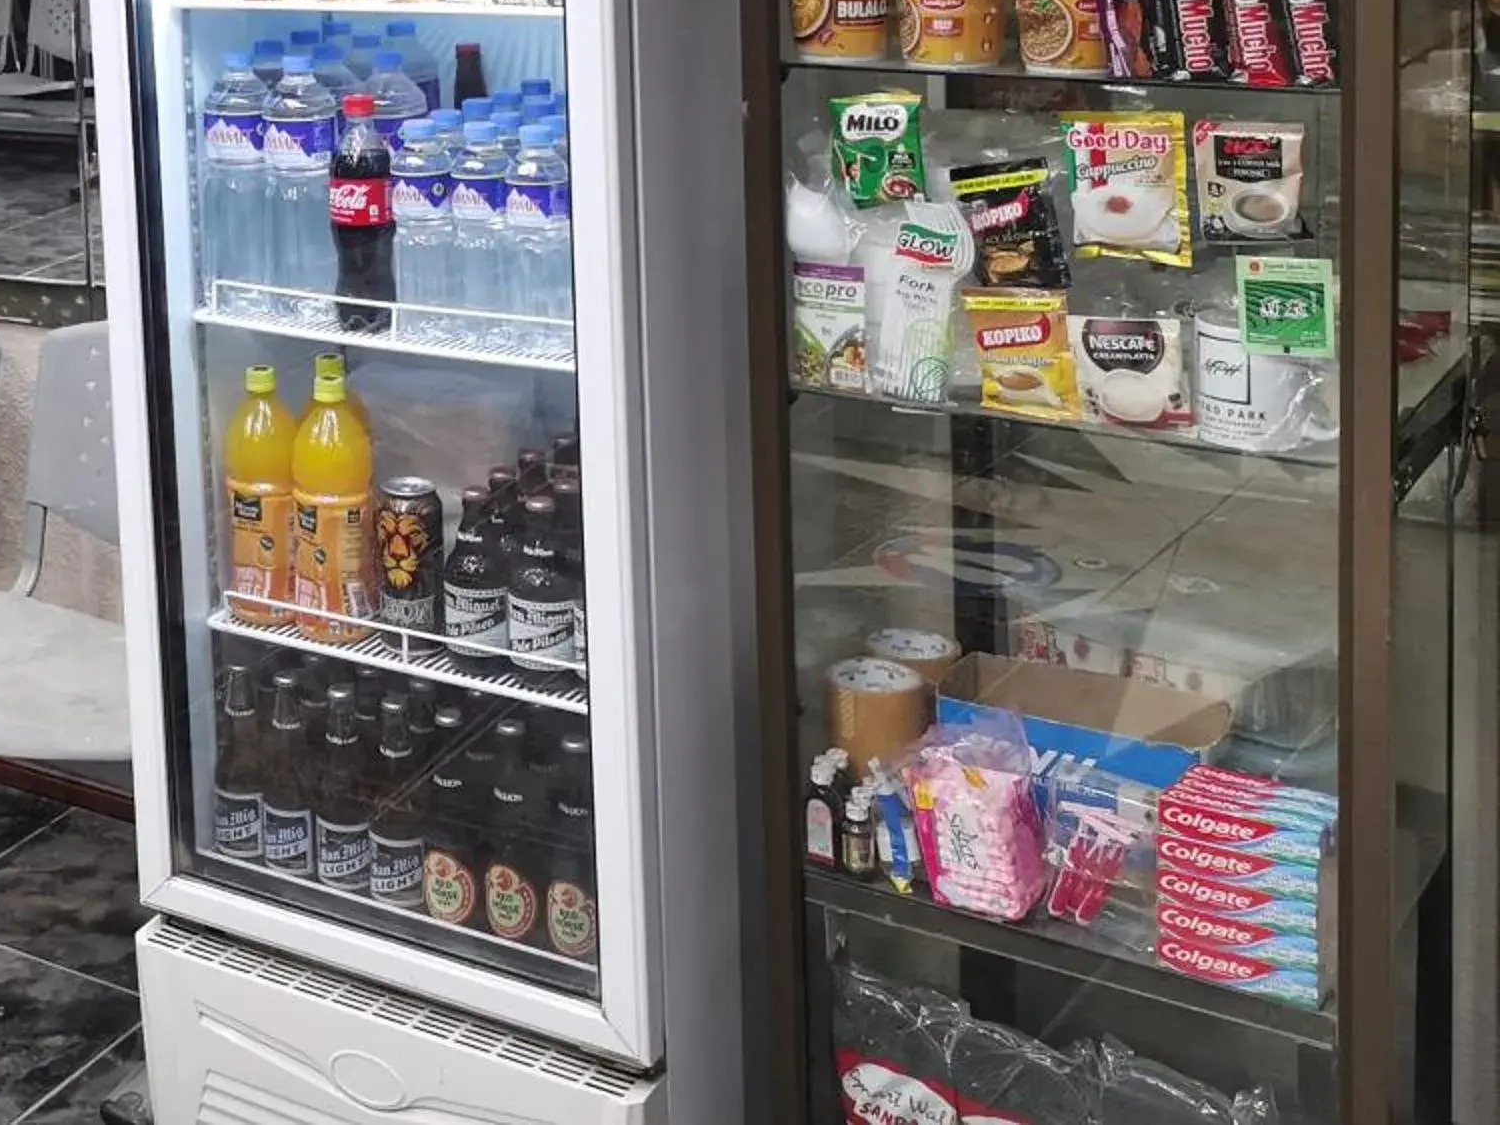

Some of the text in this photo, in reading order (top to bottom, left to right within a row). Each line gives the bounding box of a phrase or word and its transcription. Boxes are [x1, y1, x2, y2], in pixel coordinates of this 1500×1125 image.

[846, 114, 899, 132] MILO
[1069, 129, 1167, 154] Good Day
[1076, 154, 1159, 179] Cappuccino
[970, 201, 1024, 231] KOPIKO
[897, 231, 955, 257] GLOW
[899, 274, 936, 292] Fork
[982, 324, 1043, 347] KOPIKO
[1227, 408, 1267, 422] PARK
[1163, 807, 1255, 839] Colgate
[1161, 841, 1252, 874] Colgate
[1160, 875, 1251, 908] Colgate
[1161, 909, 1252, 944] Colgate
[1161, 943, 1253, 978] Colgate
